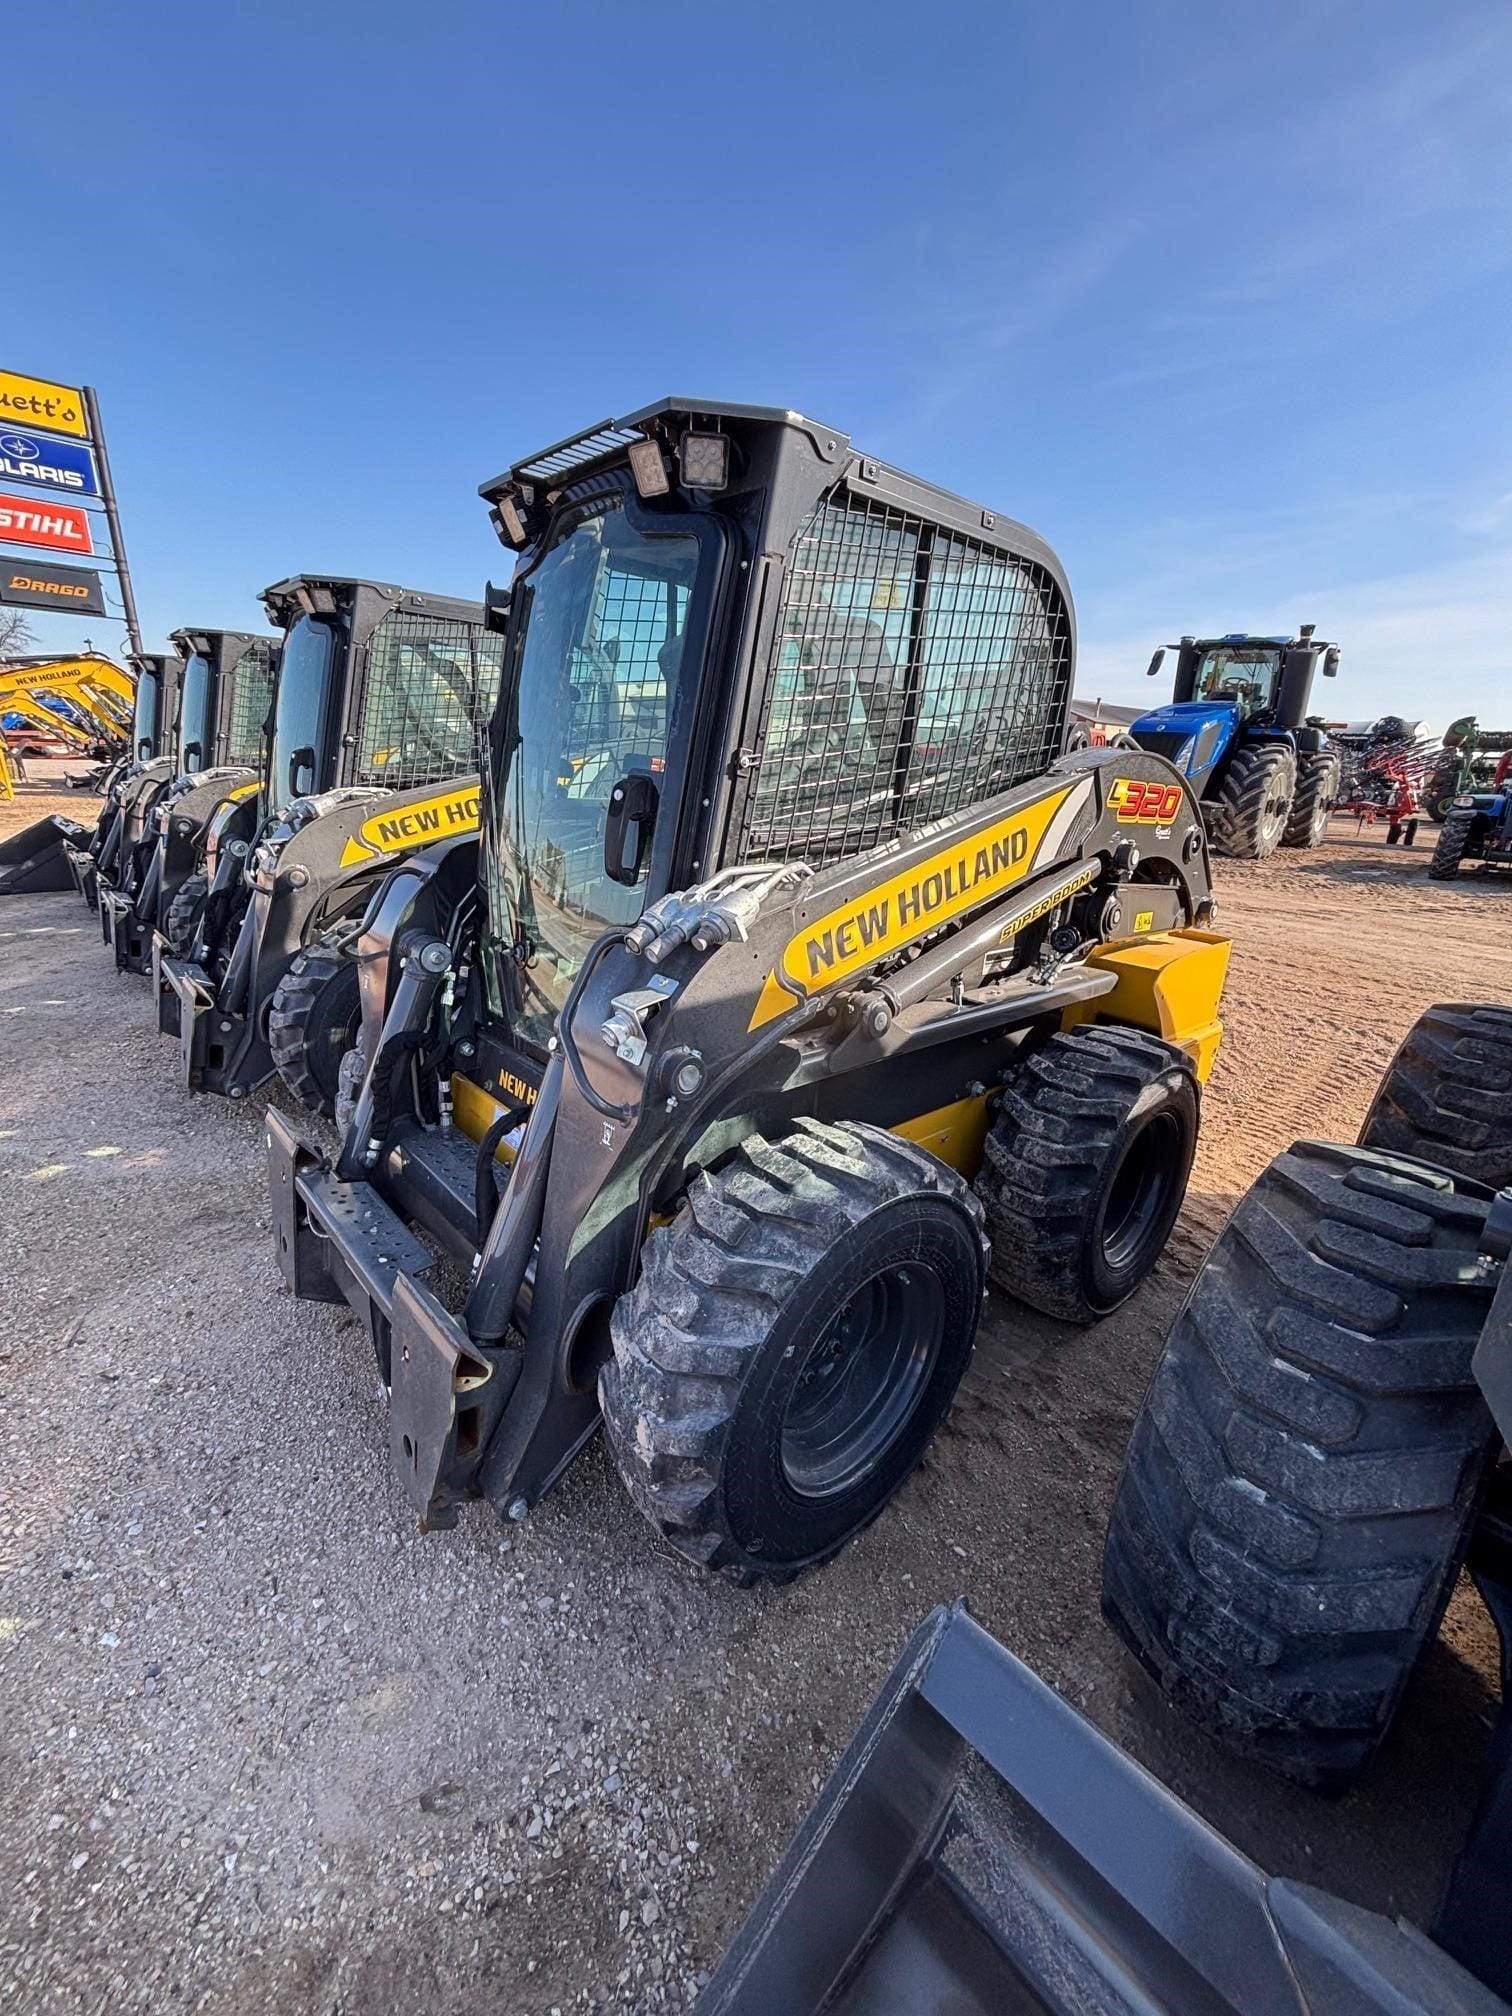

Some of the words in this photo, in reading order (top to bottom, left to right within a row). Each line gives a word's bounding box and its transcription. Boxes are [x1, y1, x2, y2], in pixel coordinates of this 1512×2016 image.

[0, 458, 84, 487] LARIS
[0, 508, 83, 539] STIHL
[9, 575, 89, 598] DRAGO
[16, 676, 38, 685] NEW
[39, 669, 81, 681] HOLLAND
[377, 808, 440, 843] NEW
[805, 897, 889, 978] NEW
[898, 827, 1029, 927] HOLLAND
[1002, 899, 1051, 938] SUPER
[1052, 870, 1091, 905] BOOM
[499, 1069, 527, 1100] NEW
